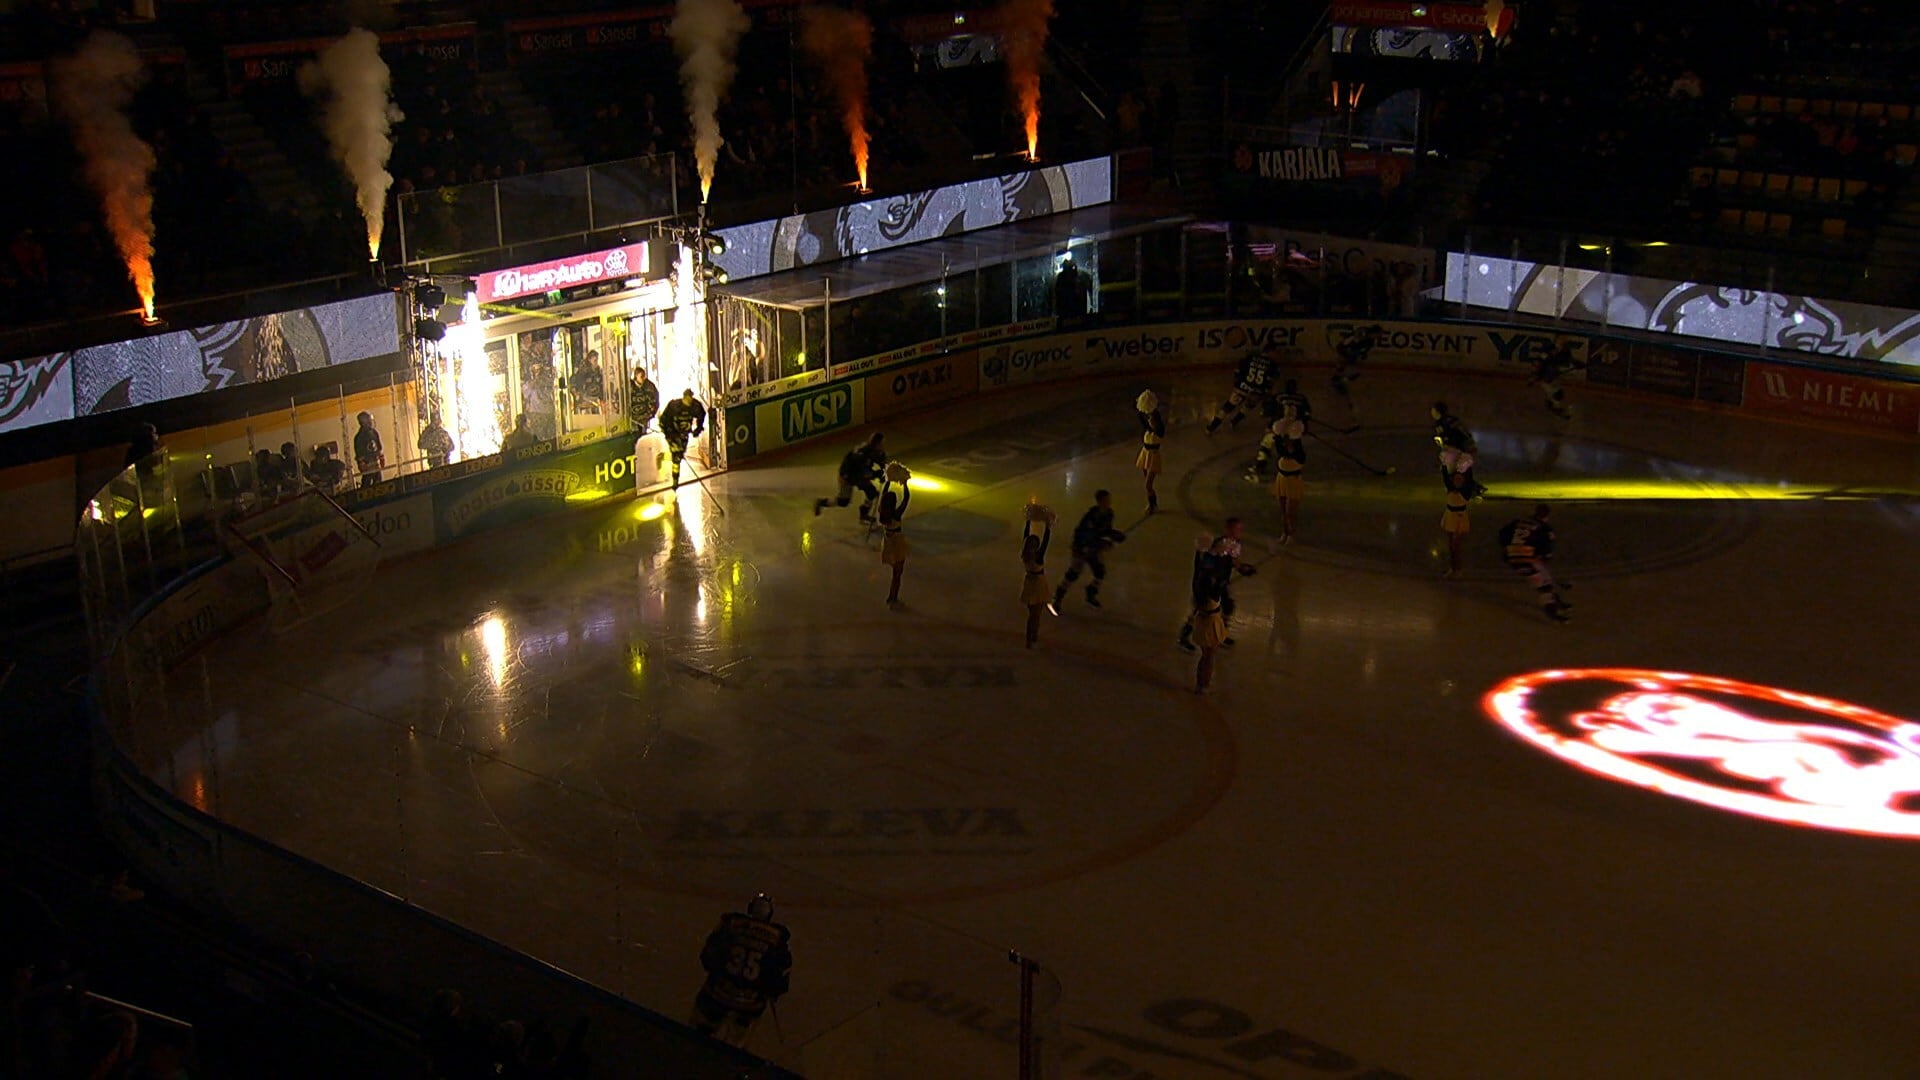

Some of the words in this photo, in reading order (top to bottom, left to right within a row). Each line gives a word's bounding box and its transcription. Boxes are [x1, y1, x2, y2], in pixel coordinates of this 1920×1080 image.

[1258, 148, 1341, 180] KARJALA
[1011, 343, 1072, 371] Gyproc
[1105, 333, 1185, 358] weber
[1374, 330, 1477, 354] EOSYNT
[1803, 380, 1895, 413] NIEMI
[787, 390, 847, 437] MSP
[667, 808, 1034, 840] KALEVA
[725, 945, 761, 981] 35
